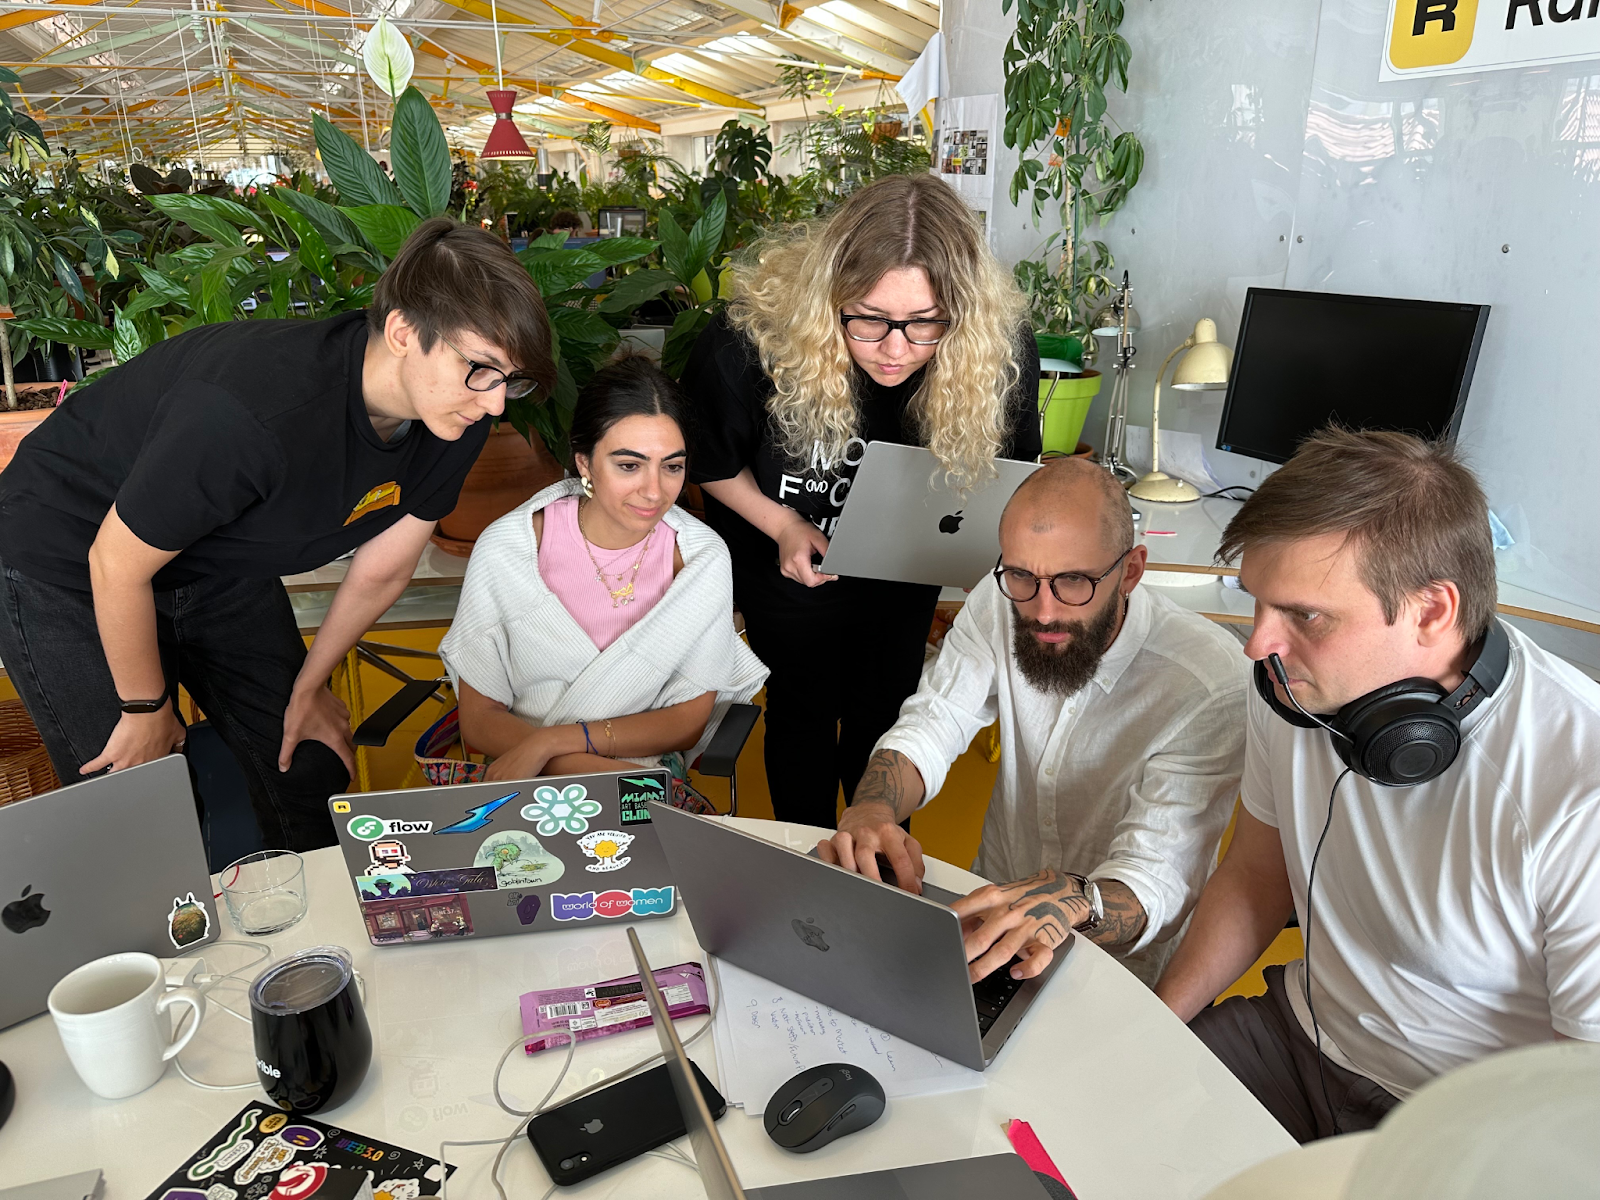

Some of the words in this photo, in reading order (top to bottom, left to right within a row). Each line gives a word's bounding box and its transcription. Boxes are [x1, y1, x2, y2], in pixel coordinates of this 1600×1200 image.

[621, 790, 666, 804] MIAMI
[621, 803, 632, 811] ART
[388, 820, 430, 834] flow
[562, 900, 598, 911] world
[600, 899, 612, 910] of
[616, 896, 664, 908] women
[334, 1137, 385, 1162] WEB3.0
